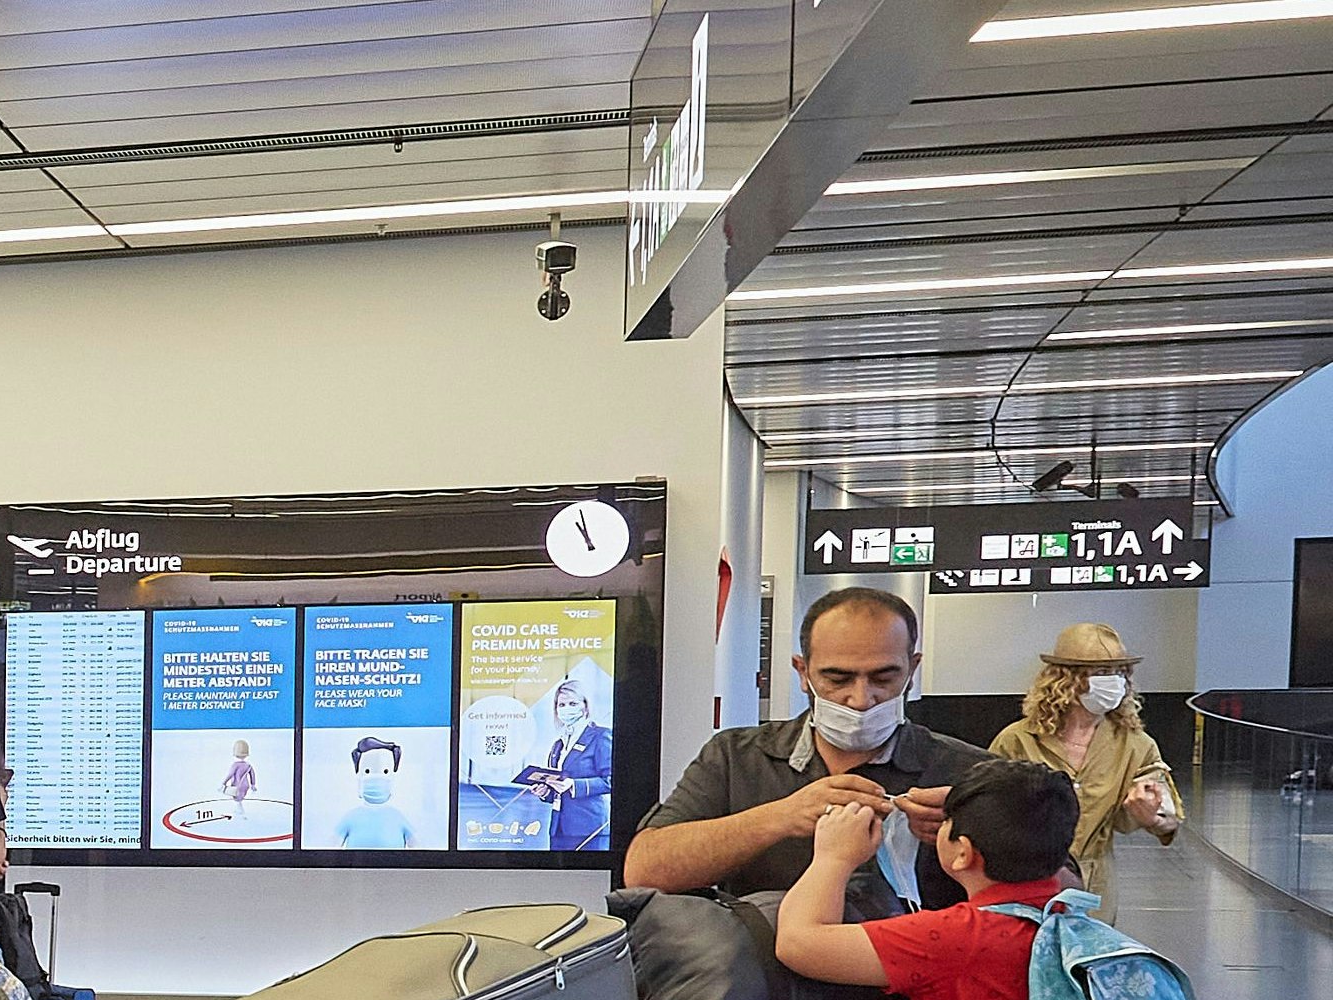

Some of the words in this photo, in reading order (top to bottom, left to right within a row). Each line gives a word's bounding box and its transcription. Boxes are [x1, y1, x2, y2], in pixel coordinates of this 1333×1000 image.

[1071, 520, 1122, 531] Terminals
[65, 529, 140, 553] Abflug
[1071, 530, 1142, 561] 1,1A
[66, 555, 182, 578] Departure
[1116, 564, 1169, 585] 1,1A
[471, 625, 517, 637] COVID
[519, 624, 559, 636] CARE
[472, 638, 540, 651] PREMIUM
[543, 637, 602, 650] SERVICE
[163, 653, 198, 664] BITTE
[200, 652, 249, 663] HALTEN
[251, 651, 270, 662] SIE
[315, 649, 352, 661] BITTE
[353, 649, 406, 660] TRAGEN
[408, 648, 429, 659] SIE
[163, 664, 242, 676] MINDESTENS
[245, 663, 283, 675] EINEN
[315, 662, 356, 673] IHREN
[358, 661, 406, 672] MUND-
[163, 677, 206, 689] METER
[208, 676, 271, 688] ABSTAND!
[315, 673, 421, 686] NASEN-SCHUTZ!
[162, 692, 194, 701] PLEASE
[195, 691, 237, 700] MAINTAIN
[239, 691, 251, 700] AT
[252, 690, 279, 699] LEAST
[314, 689, 346, 699] PLEASE
[348, 689, 375, 698] WEAR
[377, 688, 403, 697] YOUR
[167, 701, 198, 710] METER
[199, 700, 244, 710] DISTANCE!
[314, 699, 339, 708] FACE
[337, 698, 366, 708] MASK!
[196, 810, 213, 820] 1m
[53, 835, 81, 843] bitten
[83, 835, 98, 843] wir
[100, 835, 116, 844] Sie,
